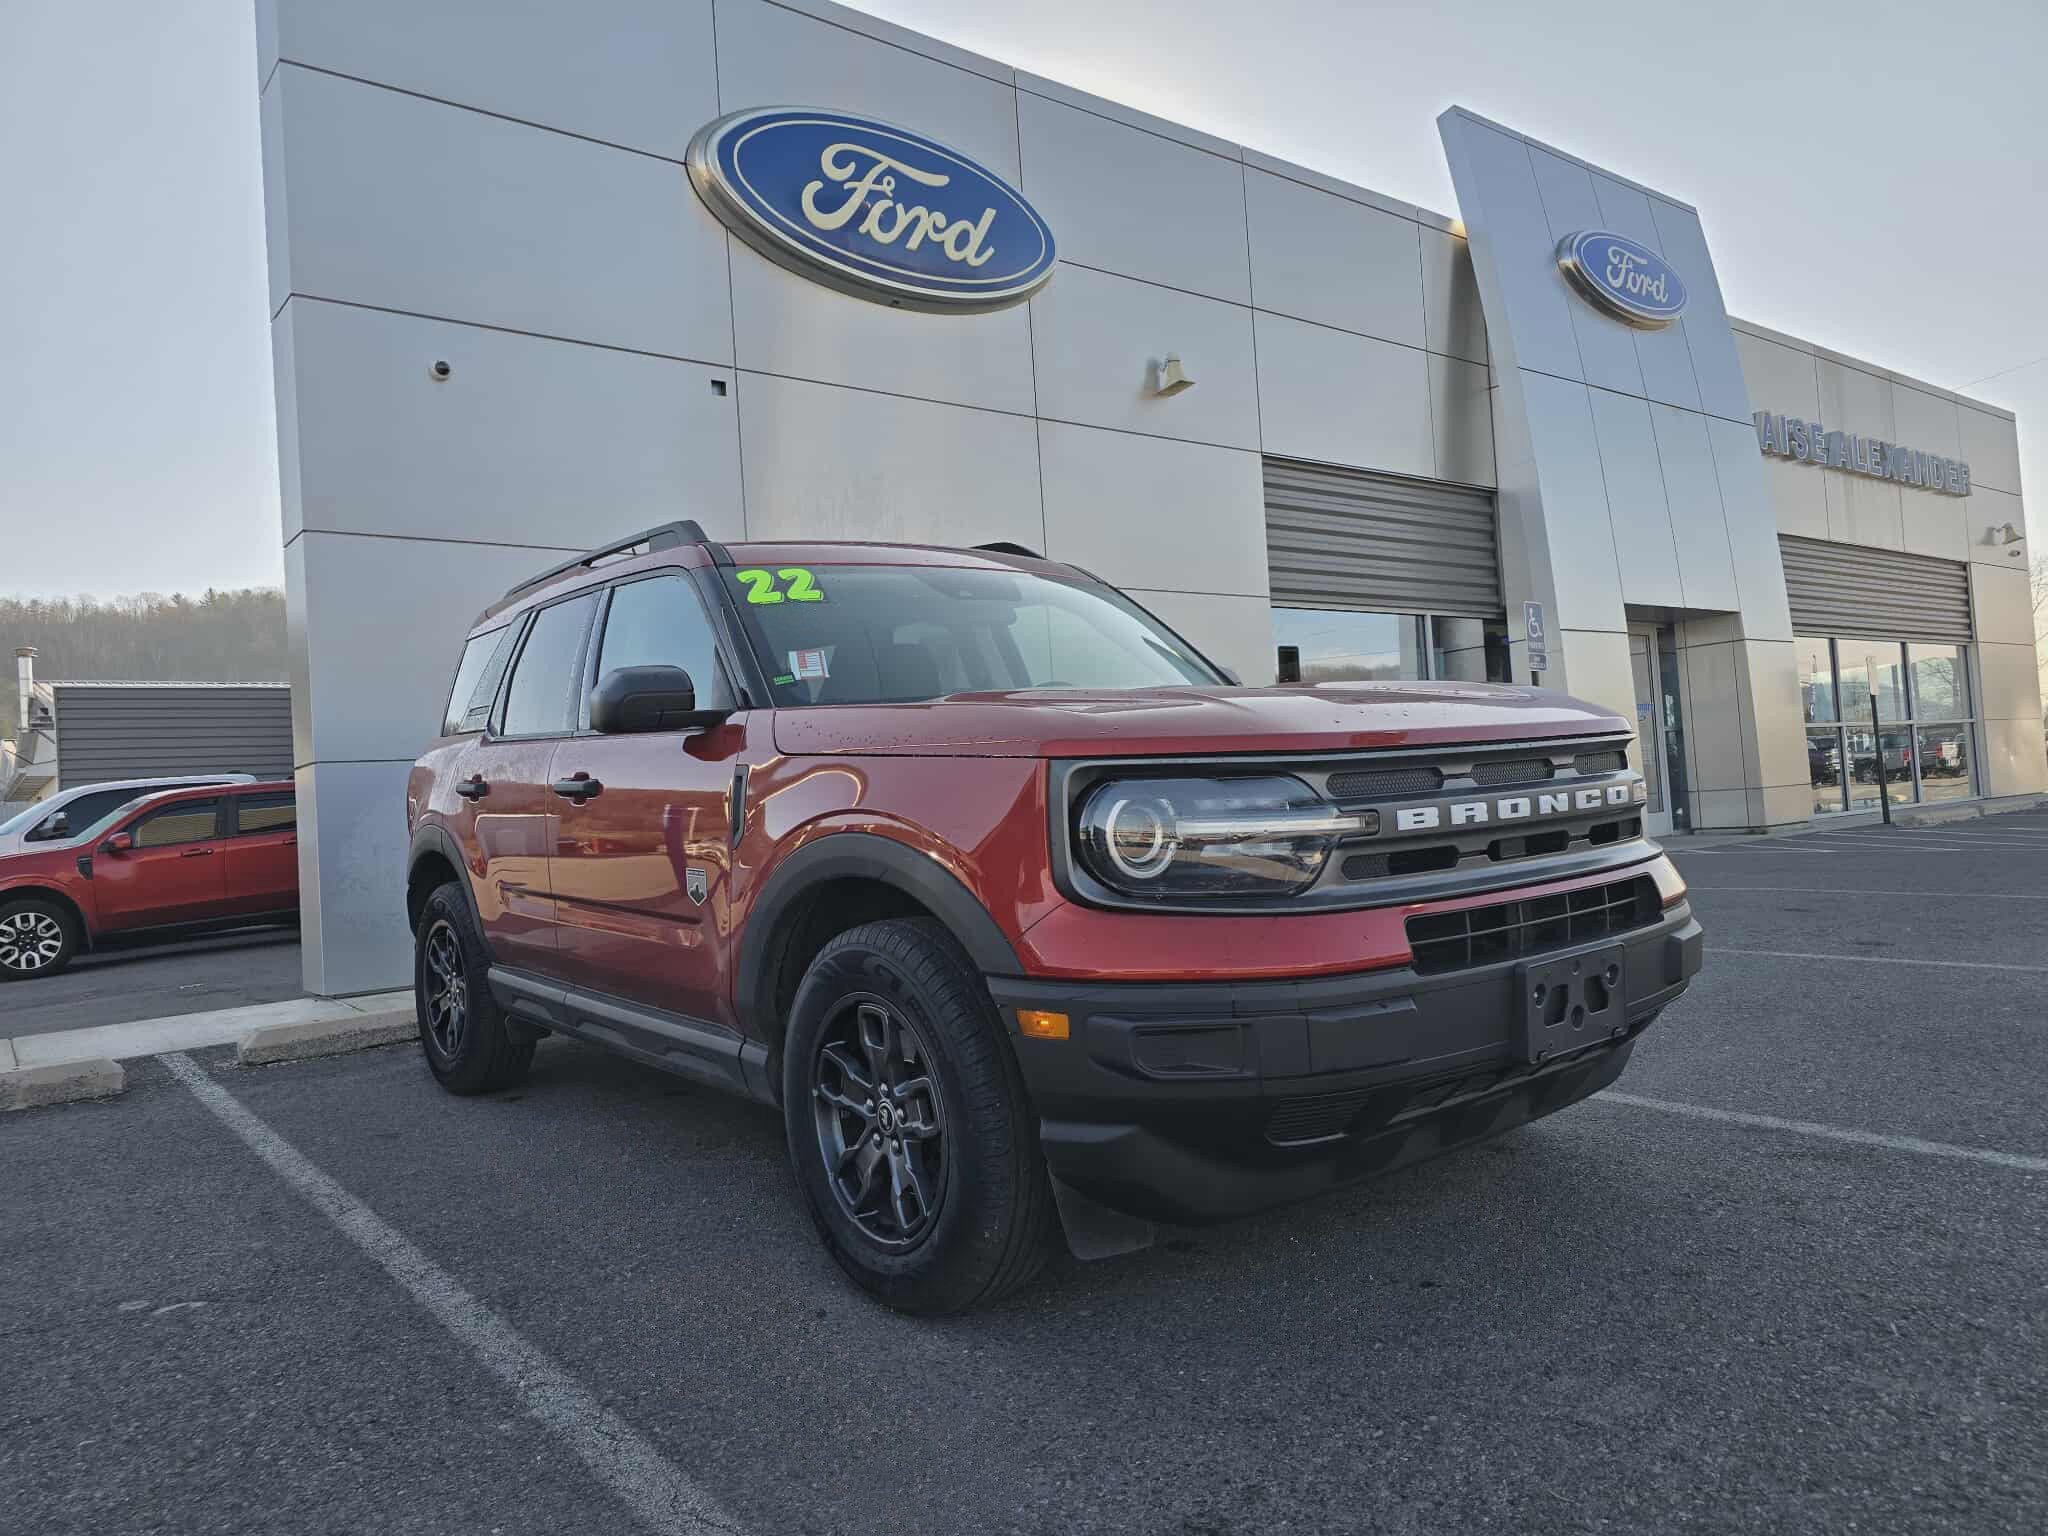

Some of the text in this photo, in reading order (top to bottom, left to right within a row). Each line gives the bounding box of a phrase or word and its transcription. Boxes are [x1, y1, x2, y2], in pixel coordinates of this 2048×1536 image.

[801, 142, 997, 267] Ford
[1606, 245, 1669, 304] Ford
[1825, 430, 1972, 496] ALEXANDER
[735, 568, 825, 605] 22
[1396, 785, 1629, 831] BRONCO
